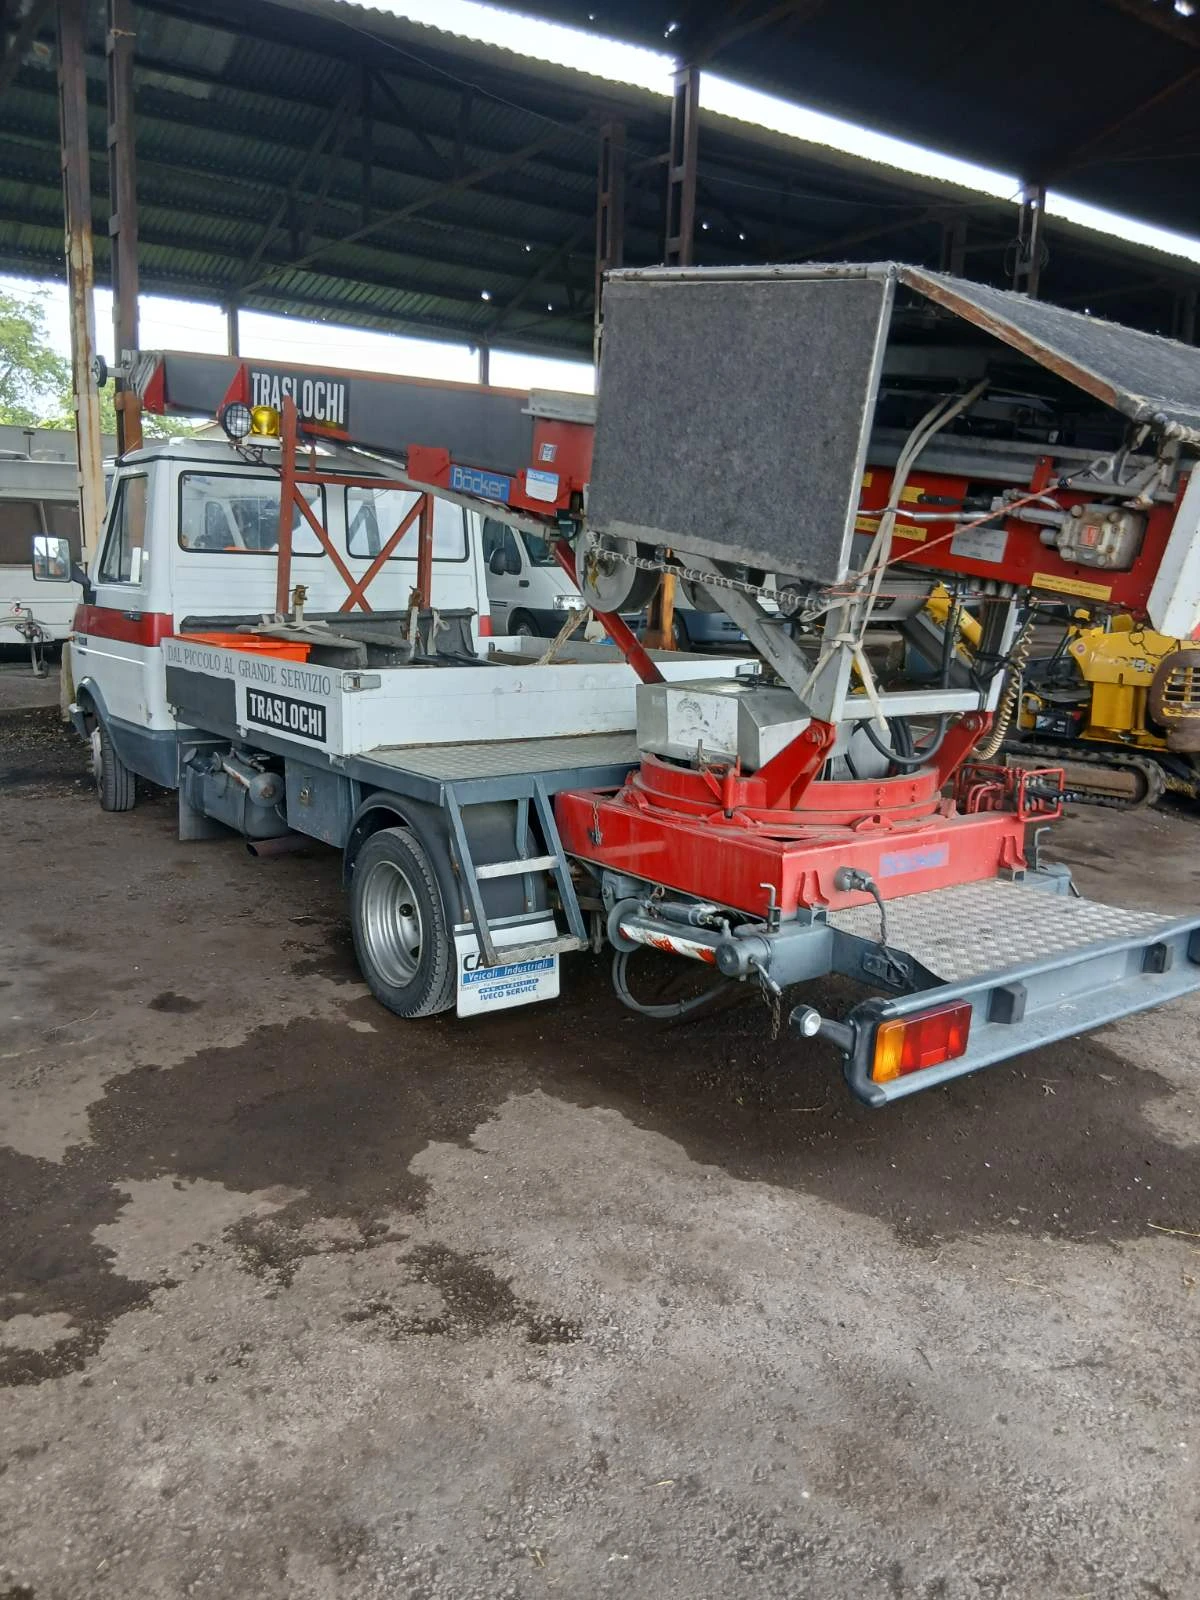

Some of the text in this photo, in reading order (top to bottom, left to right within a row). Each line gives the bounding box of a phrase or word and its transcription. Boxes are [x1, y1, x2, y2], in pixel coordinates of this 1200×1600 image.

[252, 372, 345, 425] TRASLOCHI
[453, 466, 507, 498] Böcker
[168, 645, 182, 663] DAL
[184, 648, 220, 671] PICCOLO
[224, 656, 235, 675] AL
[239, 660, 276, 684] GRANDE
[281, 668, 331, 695] SERVIZIO
[250, 693, 322, 737] TRASLOCHI
[468, 970, 498, 982] Veicoli
[504, 960, 548, 976] Industriali
[480, 991, 504, 1001] IVECO
[505, 985, 537, 997] SERVICE
